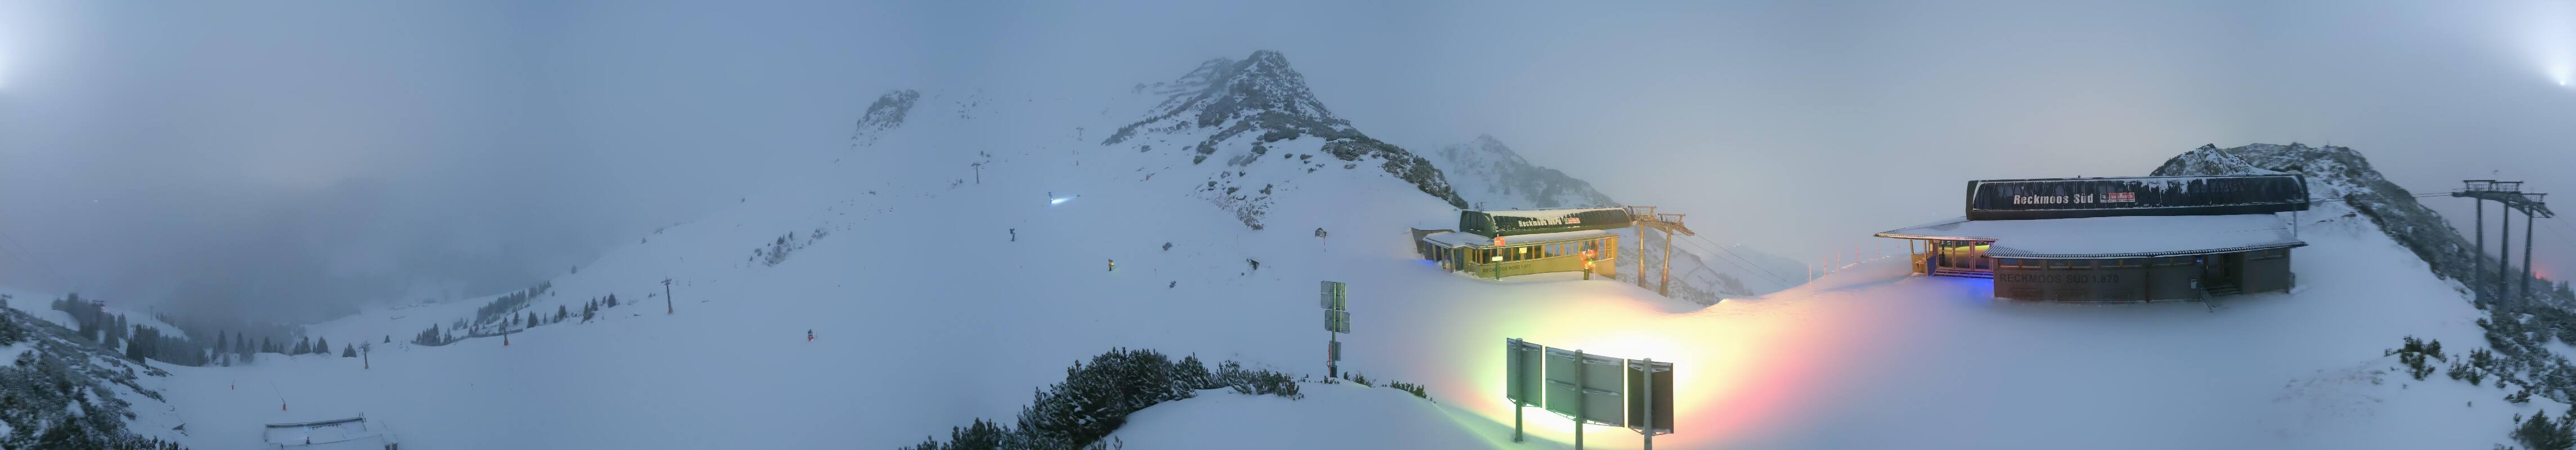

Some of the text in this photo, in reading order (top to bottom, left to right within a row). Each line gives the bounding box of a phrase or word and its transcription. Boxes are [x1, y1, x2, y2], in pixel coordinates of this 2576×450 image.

[2014, 193, 2093, 204] Reckmoos Süd
[1999, 273, 2062, 283] RECKMOOS
